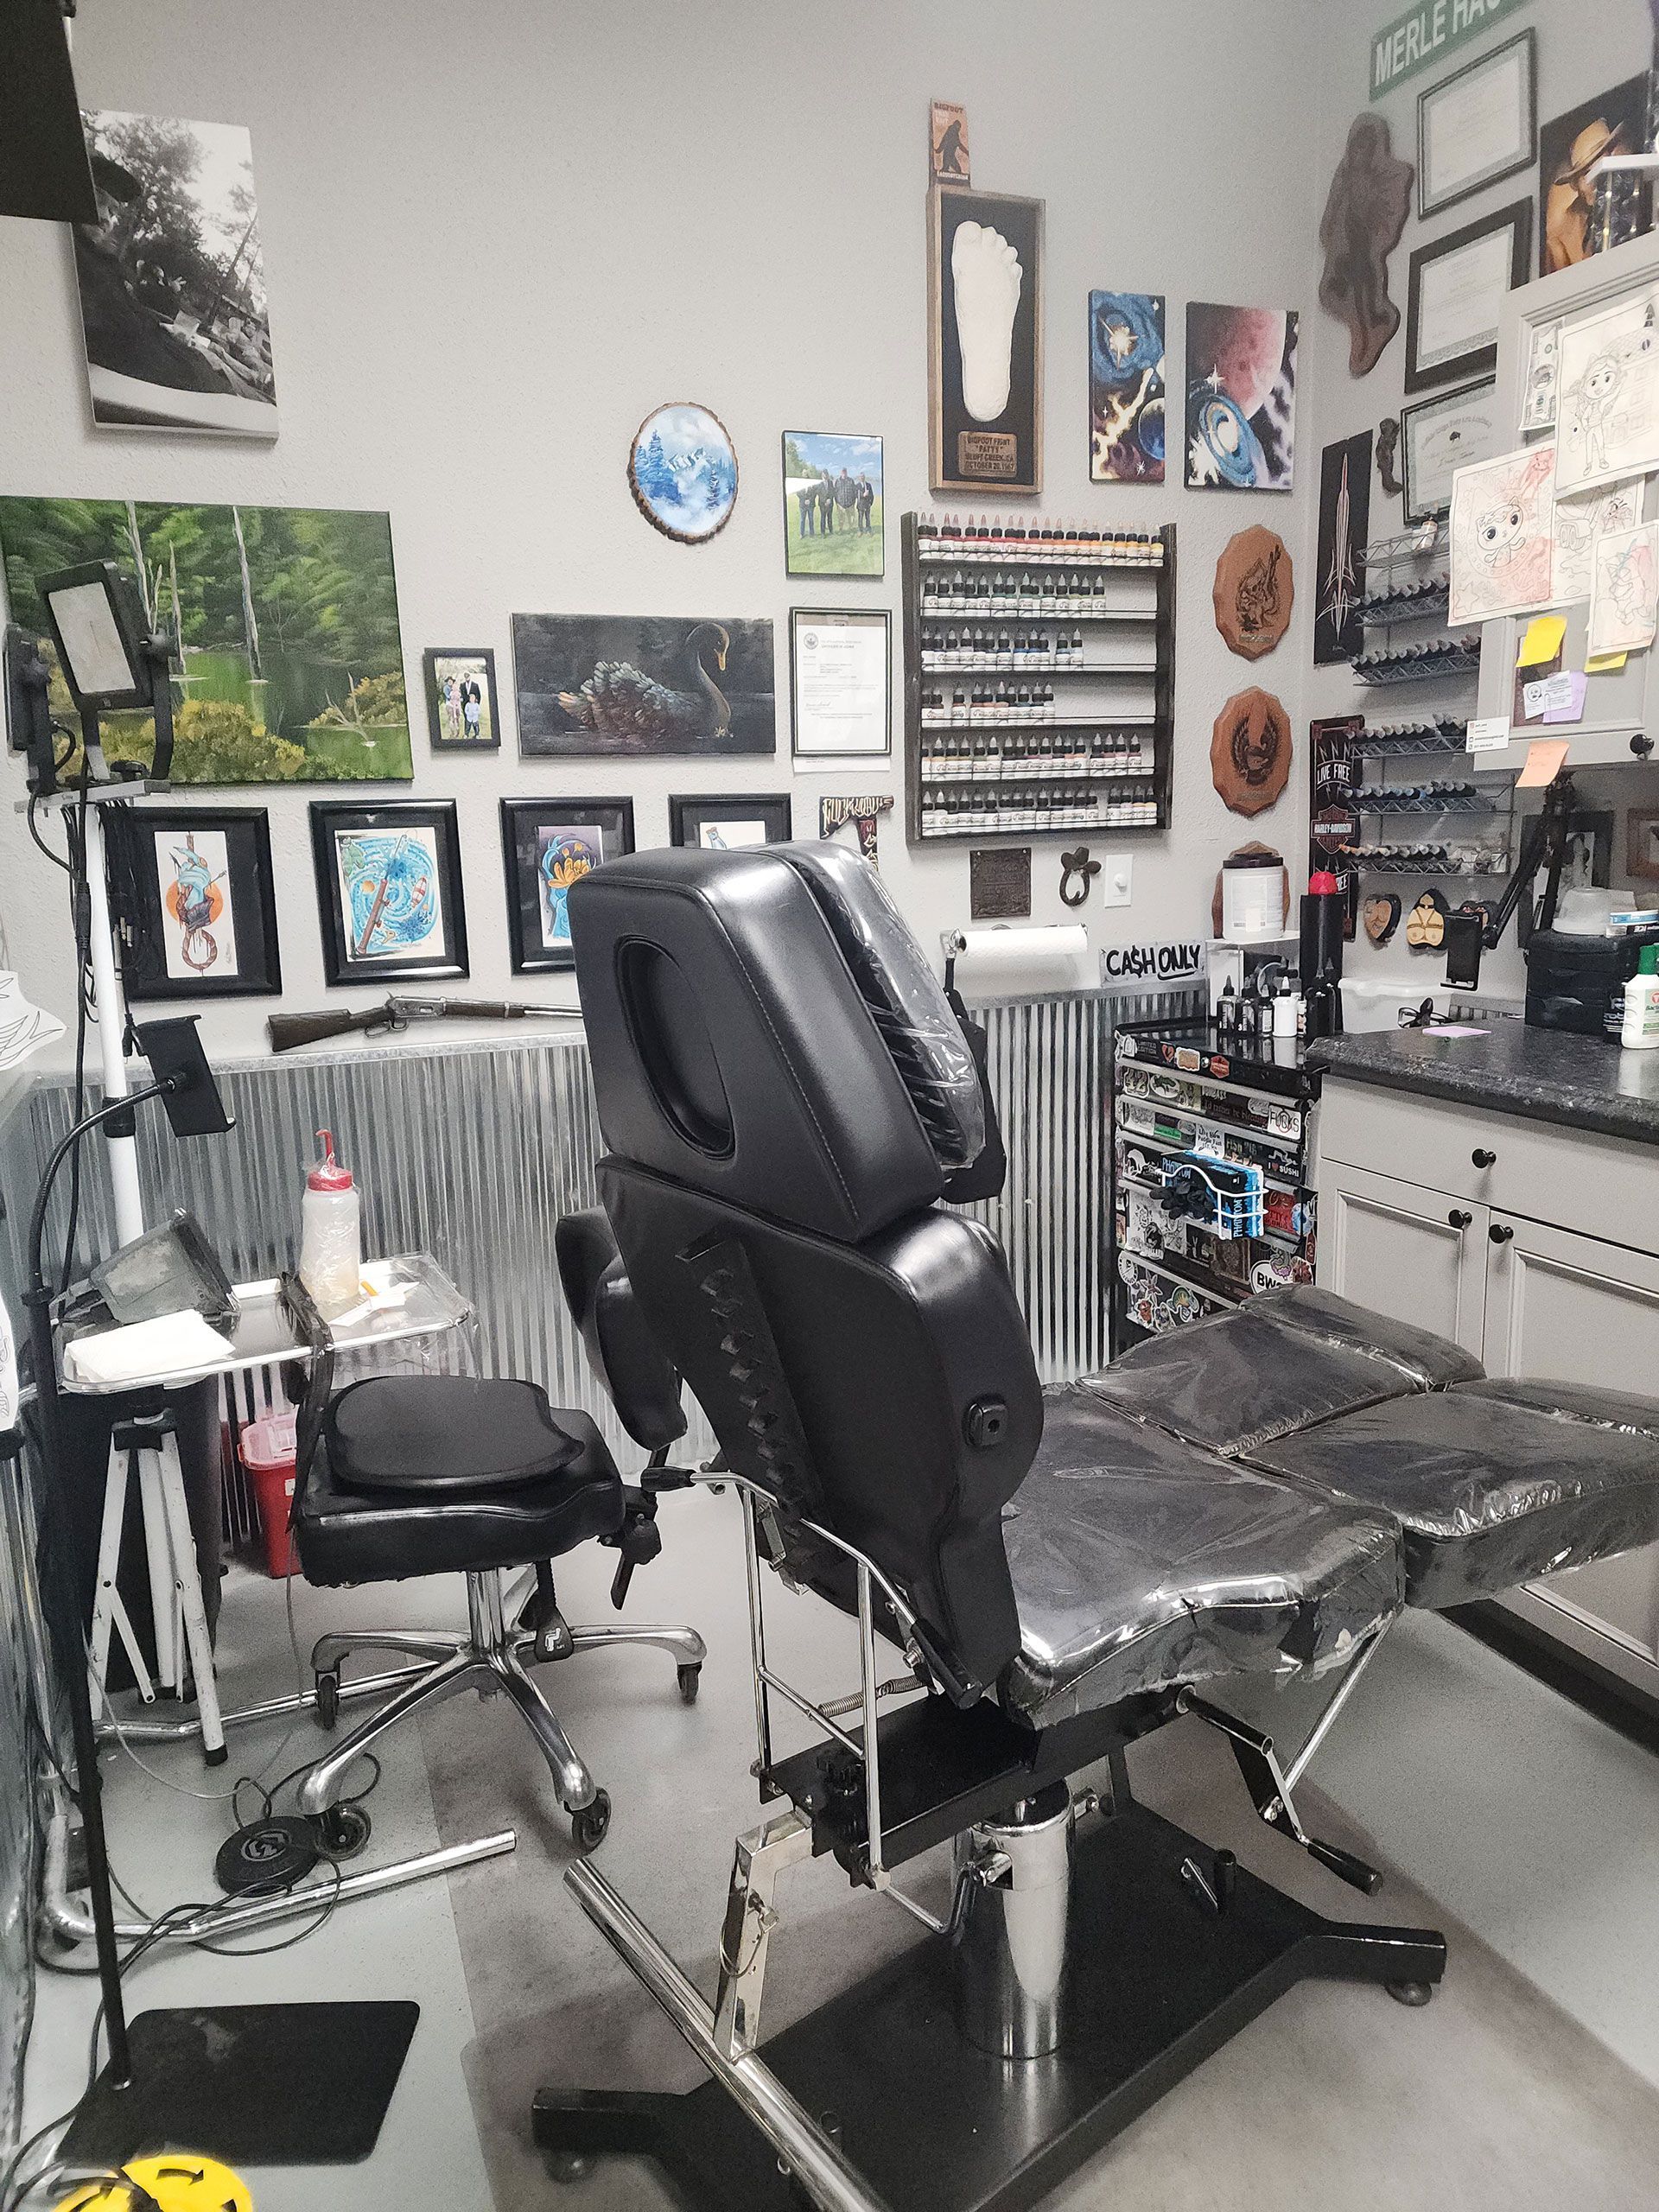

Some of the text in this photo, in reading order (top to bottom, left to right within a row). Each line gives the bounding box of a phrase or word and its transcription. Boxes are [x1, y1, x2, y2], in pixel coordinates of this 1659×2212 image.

[1376, 0, 1446, 86] MERLE
[1317, 763, 1351, 785] LIVE FREE
[1314, 823, 1352, 834] HARLEY-DAVIDSON
[1159, 944, 1200, 973] ONLY
[1279, 1166, 1300, 1178] SUSHI
